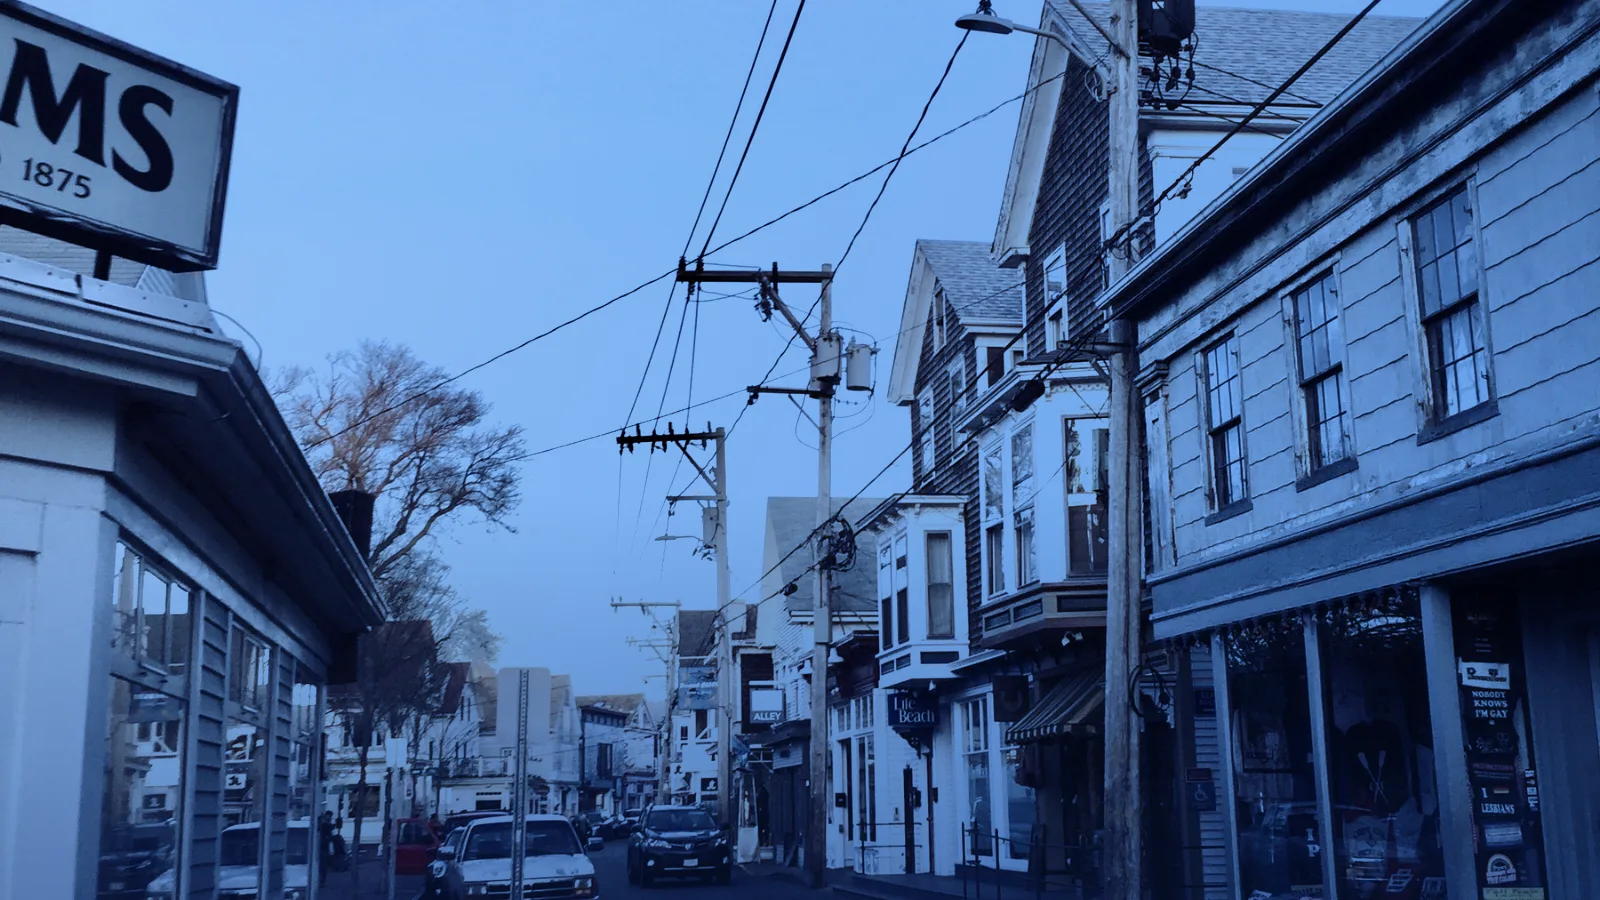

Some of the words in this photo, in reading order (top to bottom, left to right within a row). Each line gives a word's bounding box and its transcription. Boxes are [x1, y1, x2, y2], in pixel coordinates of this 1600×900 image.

[23, 157, 92, 199] 1875
[1472, 691, 1506, 700] NOBODY
[894, 696, 916, 711] Life
[1474, 699, 1508, 709] KNOWS
[753, 712, 782, 721] ALLEY
[899, 709, 935, 724] Beach
[1475, 710, 1489, 719] I'M
[1490, 709, 1508, 719] GAY
[1481, 803, 1515, 815] LESBIANS
